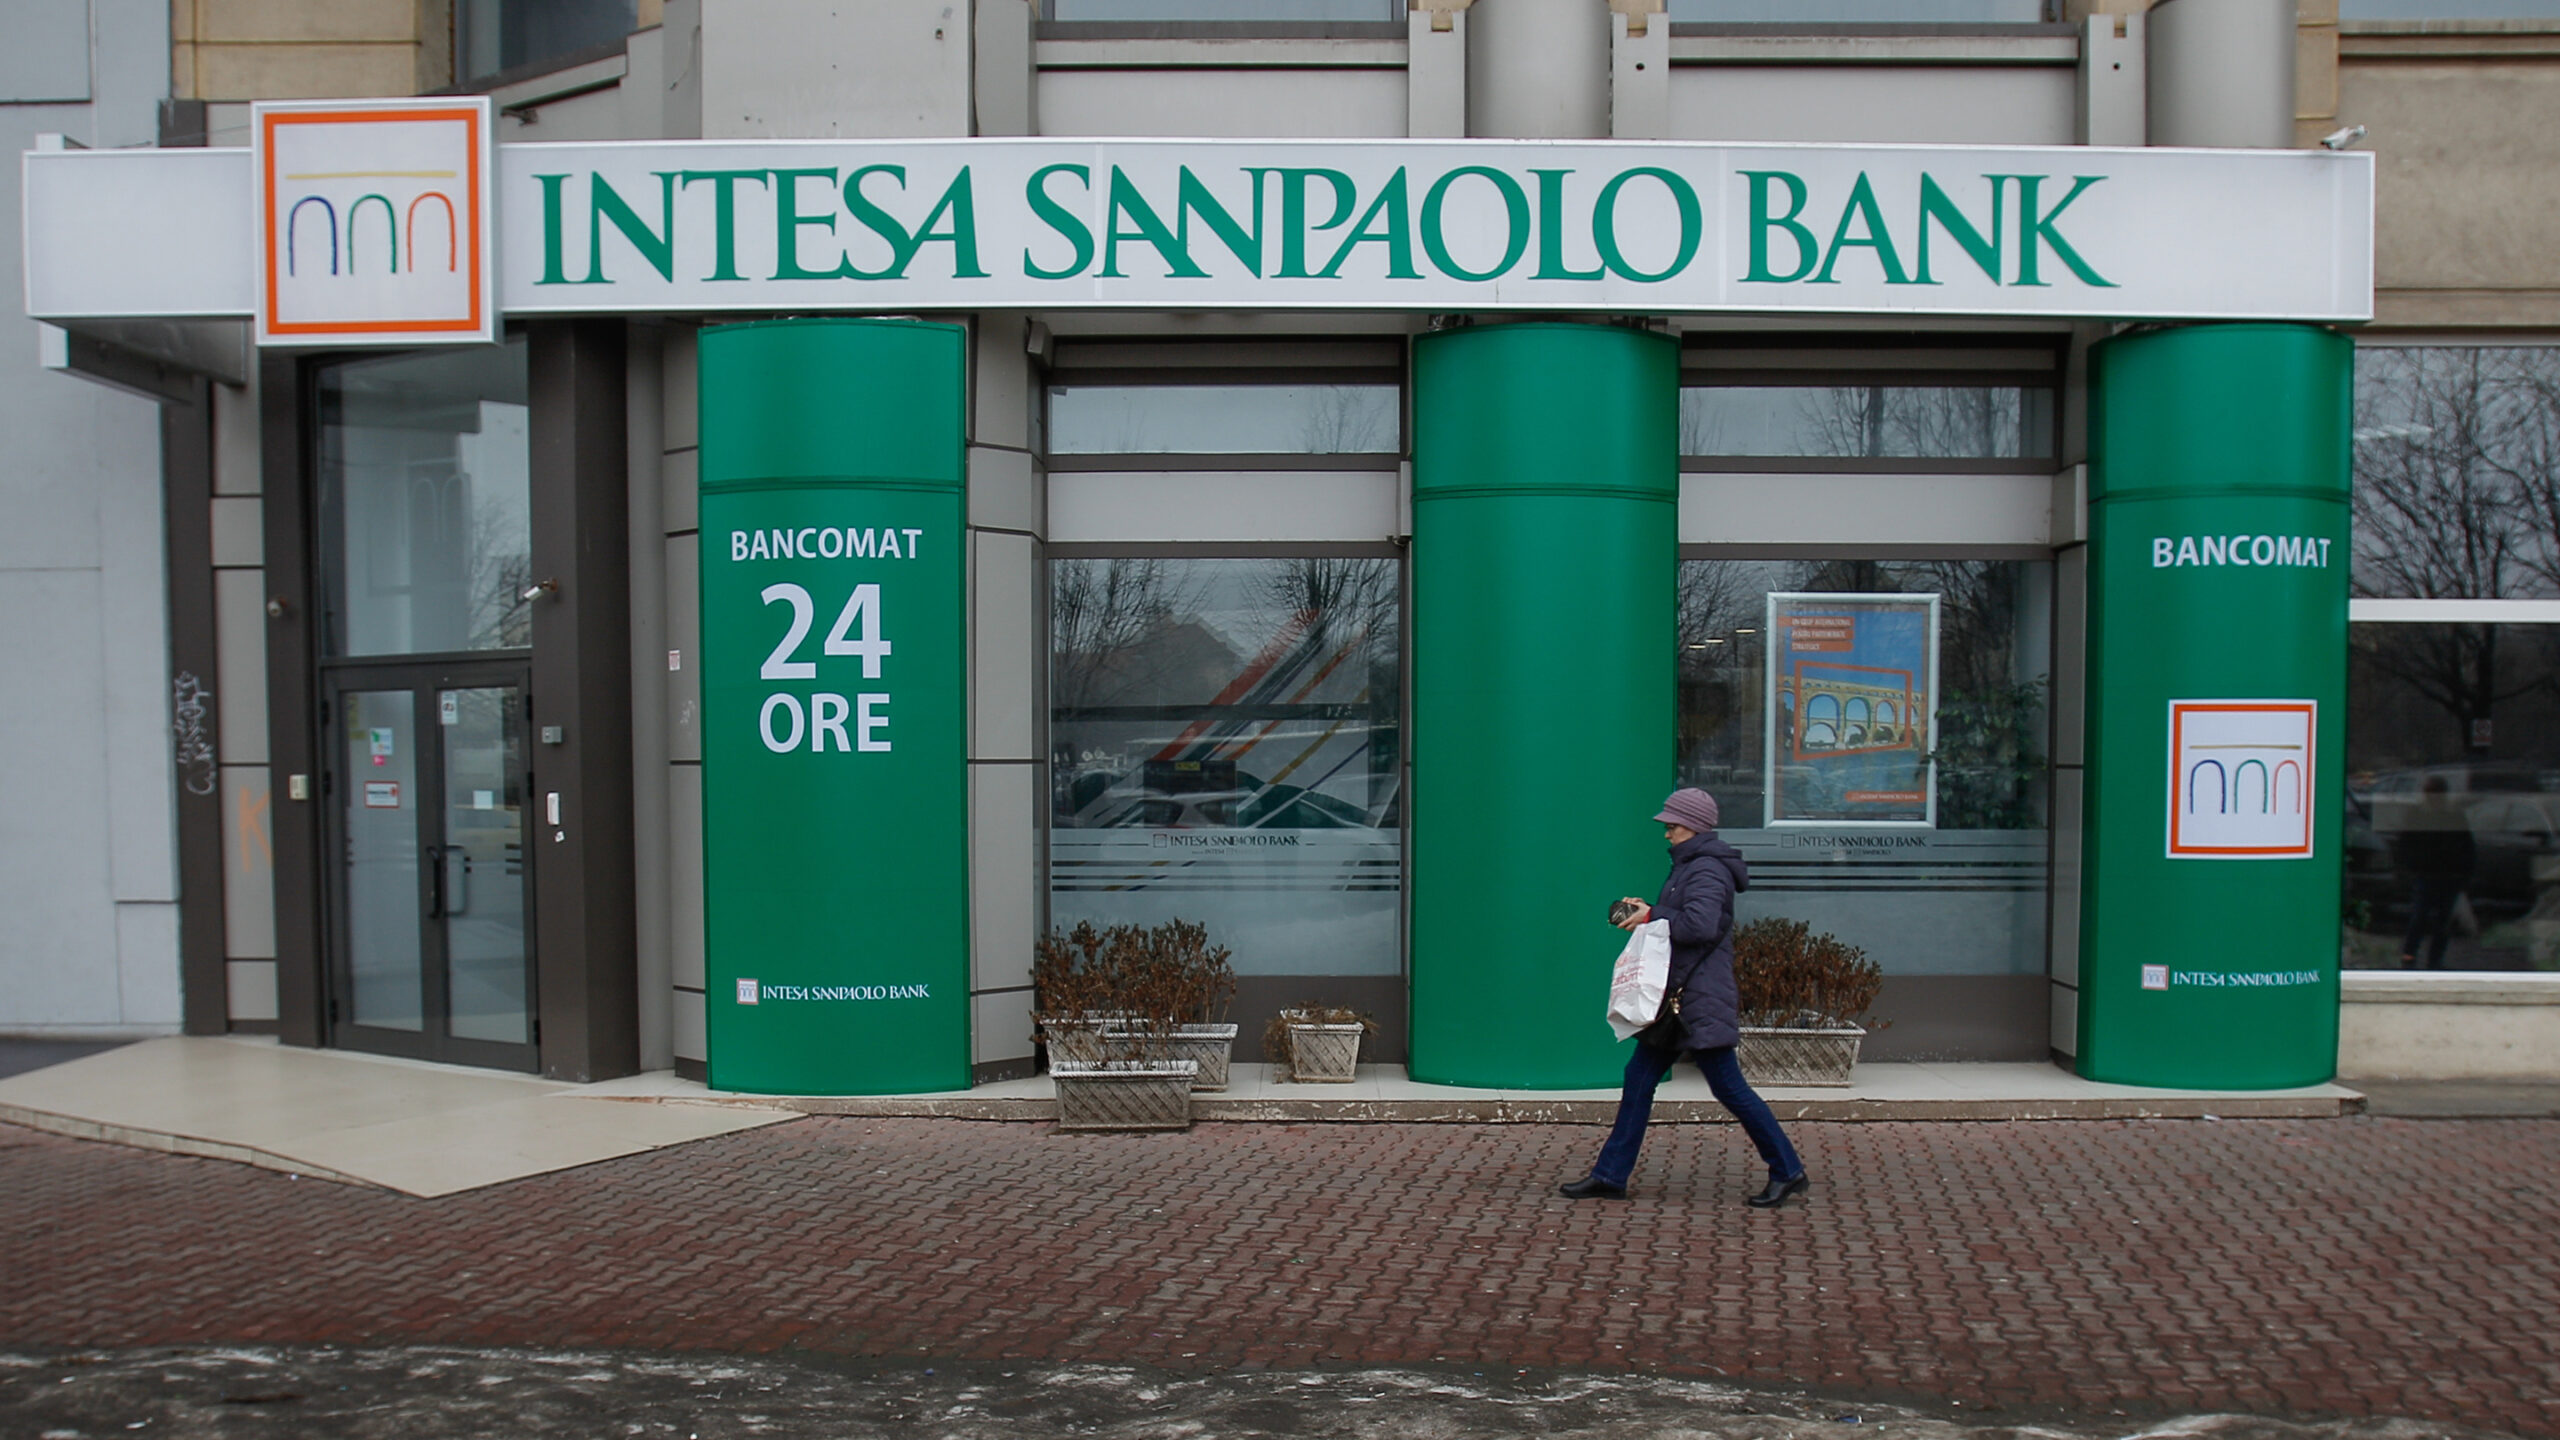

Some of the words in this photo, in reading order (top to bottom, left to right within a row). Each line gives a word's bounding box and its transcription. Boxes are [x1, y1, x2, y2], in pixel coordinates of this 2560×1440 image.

[532, 163, 991, 286] INTESA
[1024, 162, 1703, 283] SANPAOLO
[1738, 169, 2121, 288] BANK
[731, 527, 923, 561] BANCOMAT
[2153, 535, 2331, 568] BANCOMAT
[760, 583, 892, 680] 24
[759, 692, 892, 753] ORE
[1170, 835, 1208, 847] INTESA
[1211, 834, 1267, 847] SANPAOLO
[1269, 834, 1300, 847] BANK
[1799, 835, 1836, 848] INTESA
[1838, 835, 1894, 848] SANPAOLO
[1896, 835, 1927, 848] BANK
[763, 985, 809, 1001] INTESA
[812, 985, 887, 1001] SANPAOLO
[889, 984, 931, 999] BANK
[2174, 971, 2226, 986] INTESA
[2229, 972, 2295, 987] SANPAOLO
[2296, 970, 2321, 984] BANK
